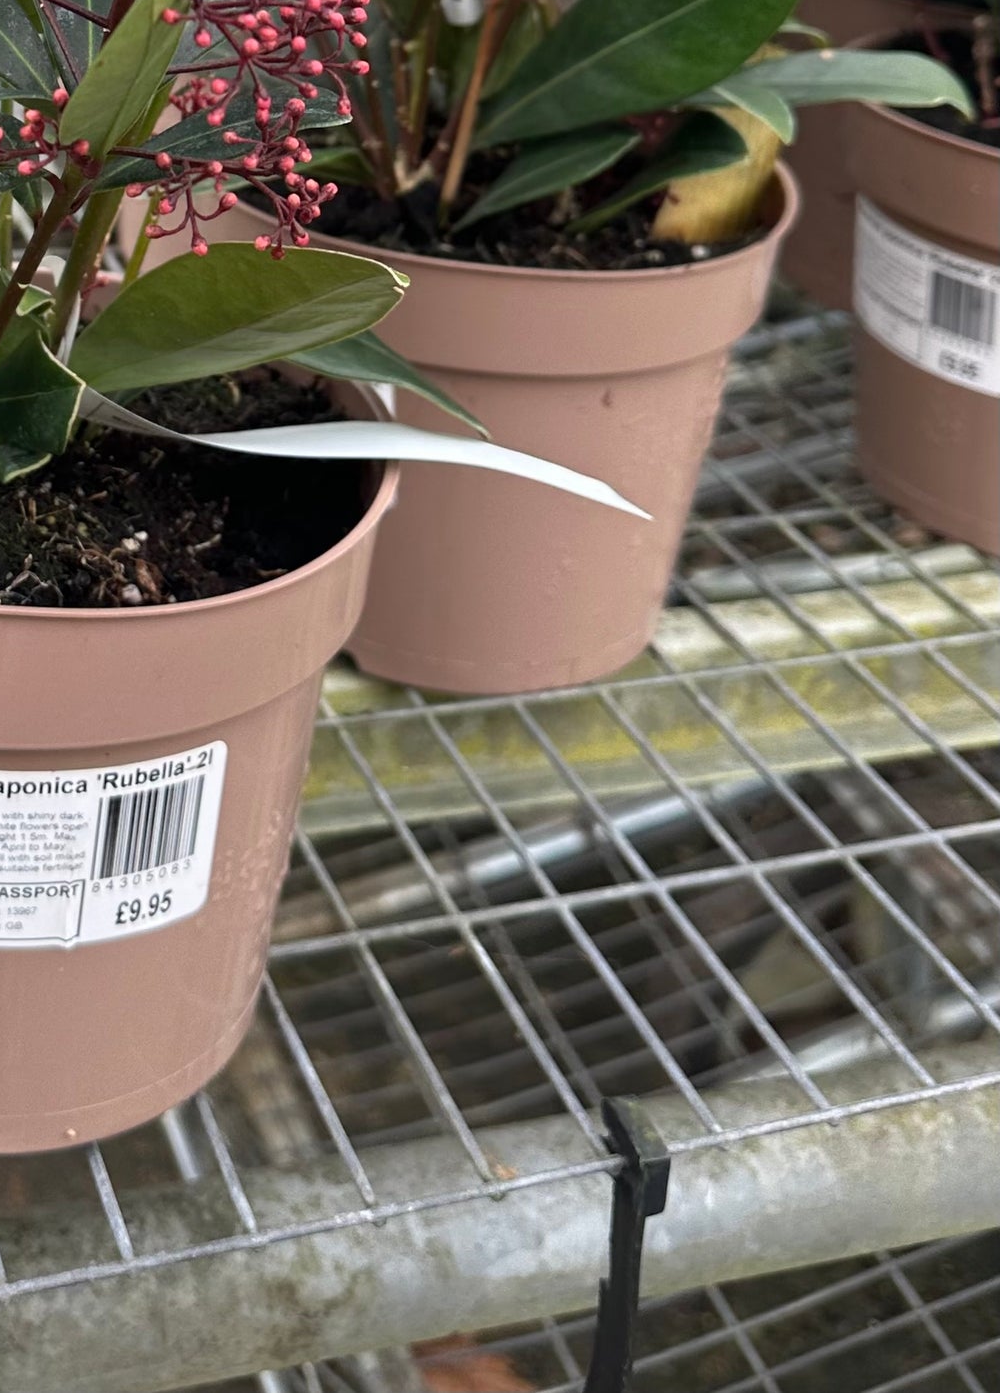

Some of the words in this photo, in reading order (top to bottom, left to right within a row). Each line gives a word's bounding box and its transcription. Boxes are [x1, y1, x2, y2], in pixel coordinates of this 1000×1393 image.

[2, 810, 25, 820] with
[27, 811, 56, 821] shiny
[59, 810, 85, 820] dark
[20, 820, 60, 831] flowers
[61, 821, 89, 832] open
[1, 842, 27, 852] April
[29, 843, 40, 851] to
[8, 853, 31, 862] with
[33, 852, 53, 862] soil
[114, 888, 173, 925] £9.95
